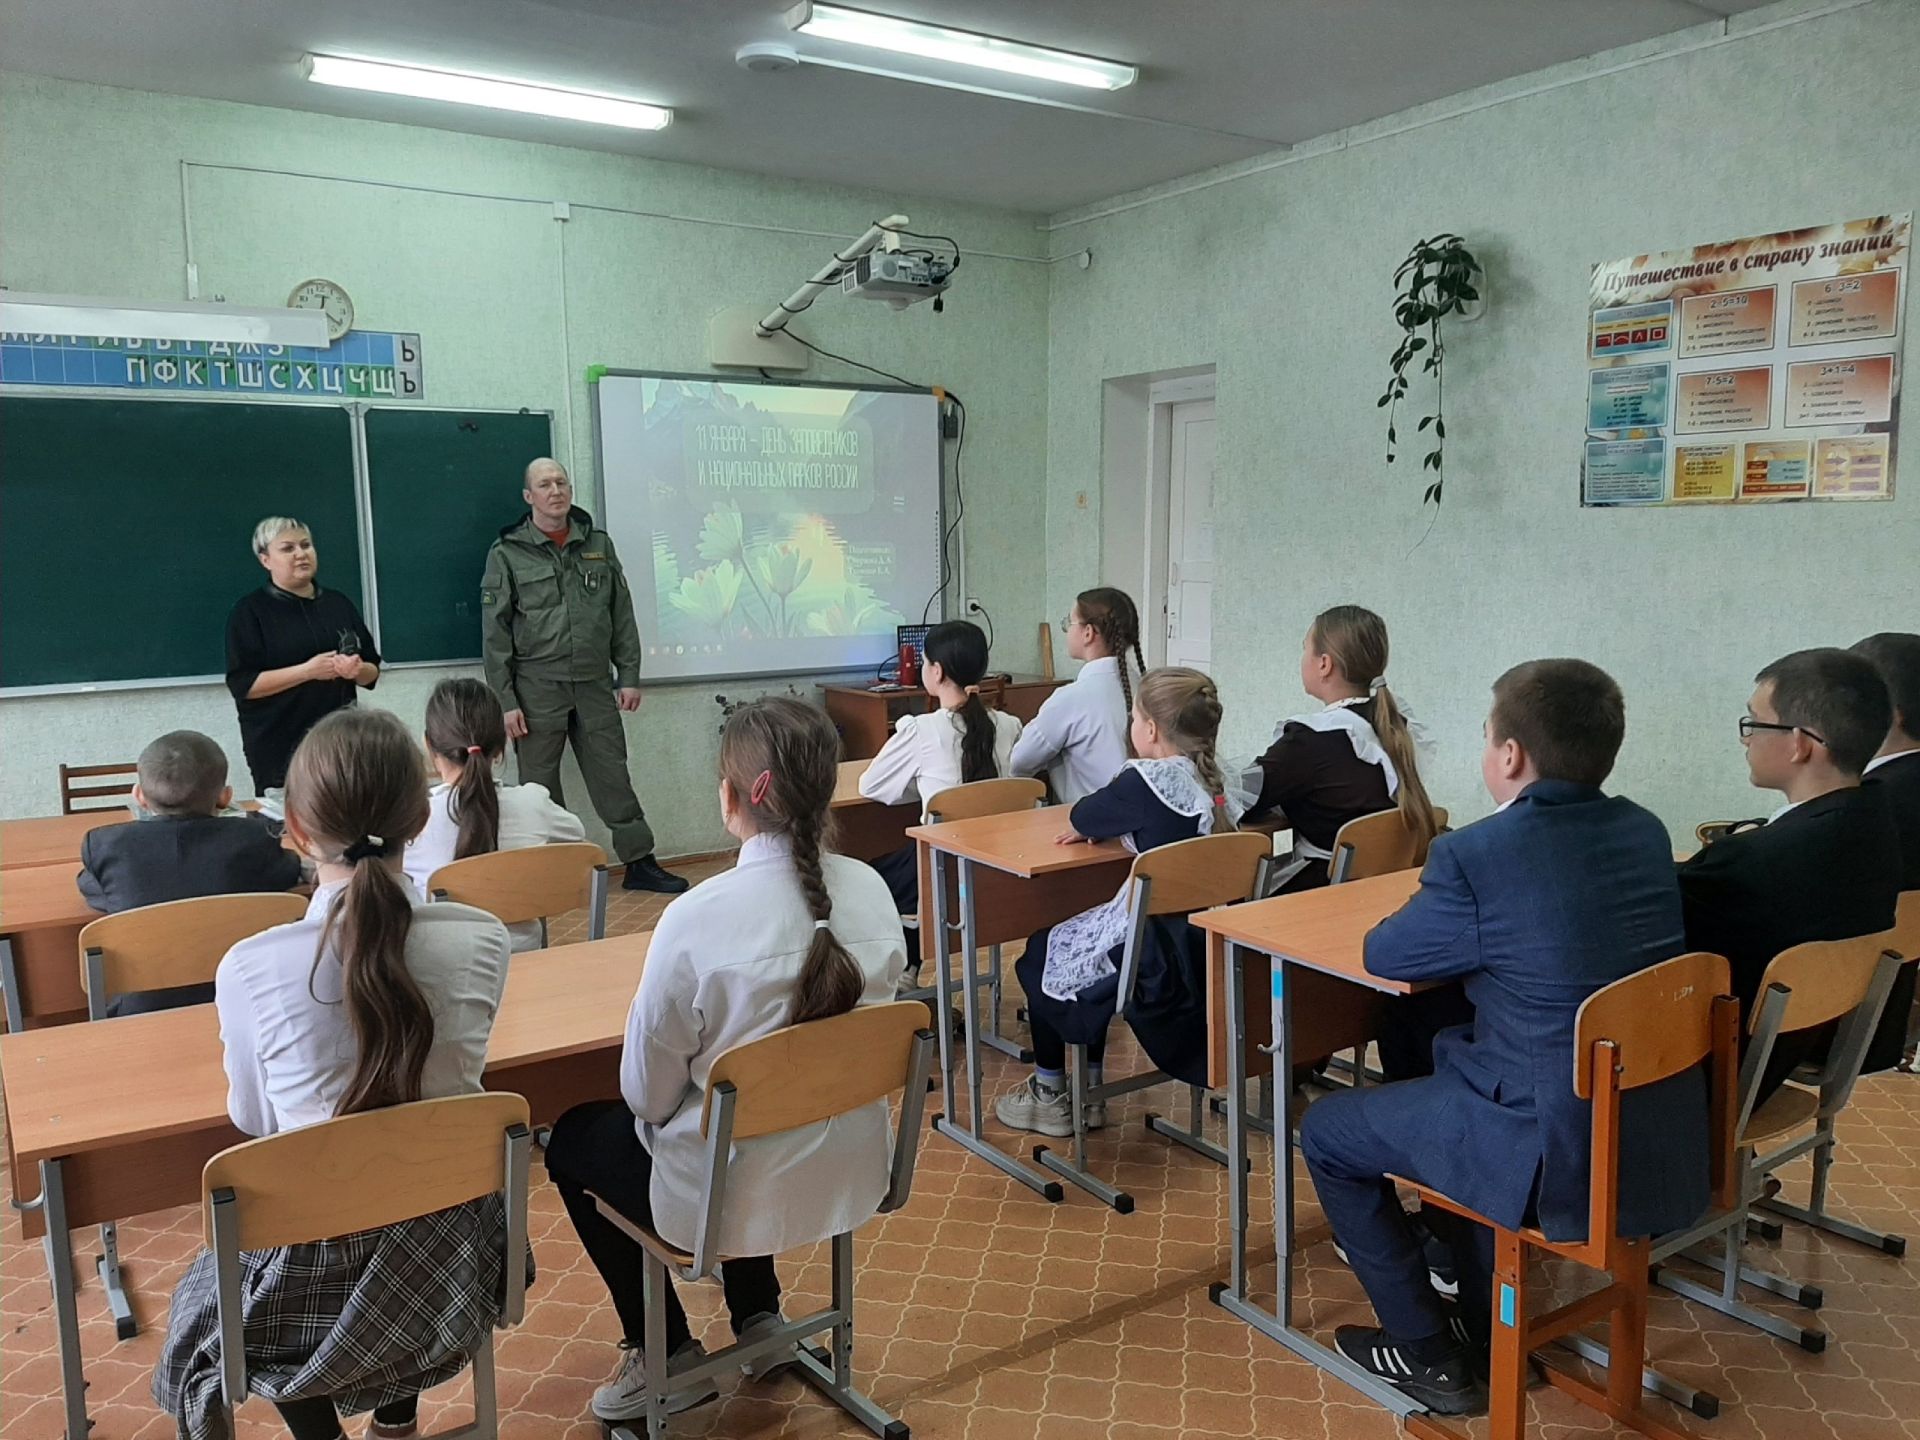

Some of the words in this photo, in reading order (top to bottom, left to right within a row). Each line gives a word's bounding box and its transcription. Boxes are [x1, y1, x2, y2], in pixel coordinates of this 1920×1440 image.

[1602, 260, 1725, 291] Путешествие
[1729, 260, 1738, 271] в
[1744, 248, 1814, 273] страну
[1819, 229, 1894, 258] знаний
[761, 427, 787, 457] ДЕНЬ
